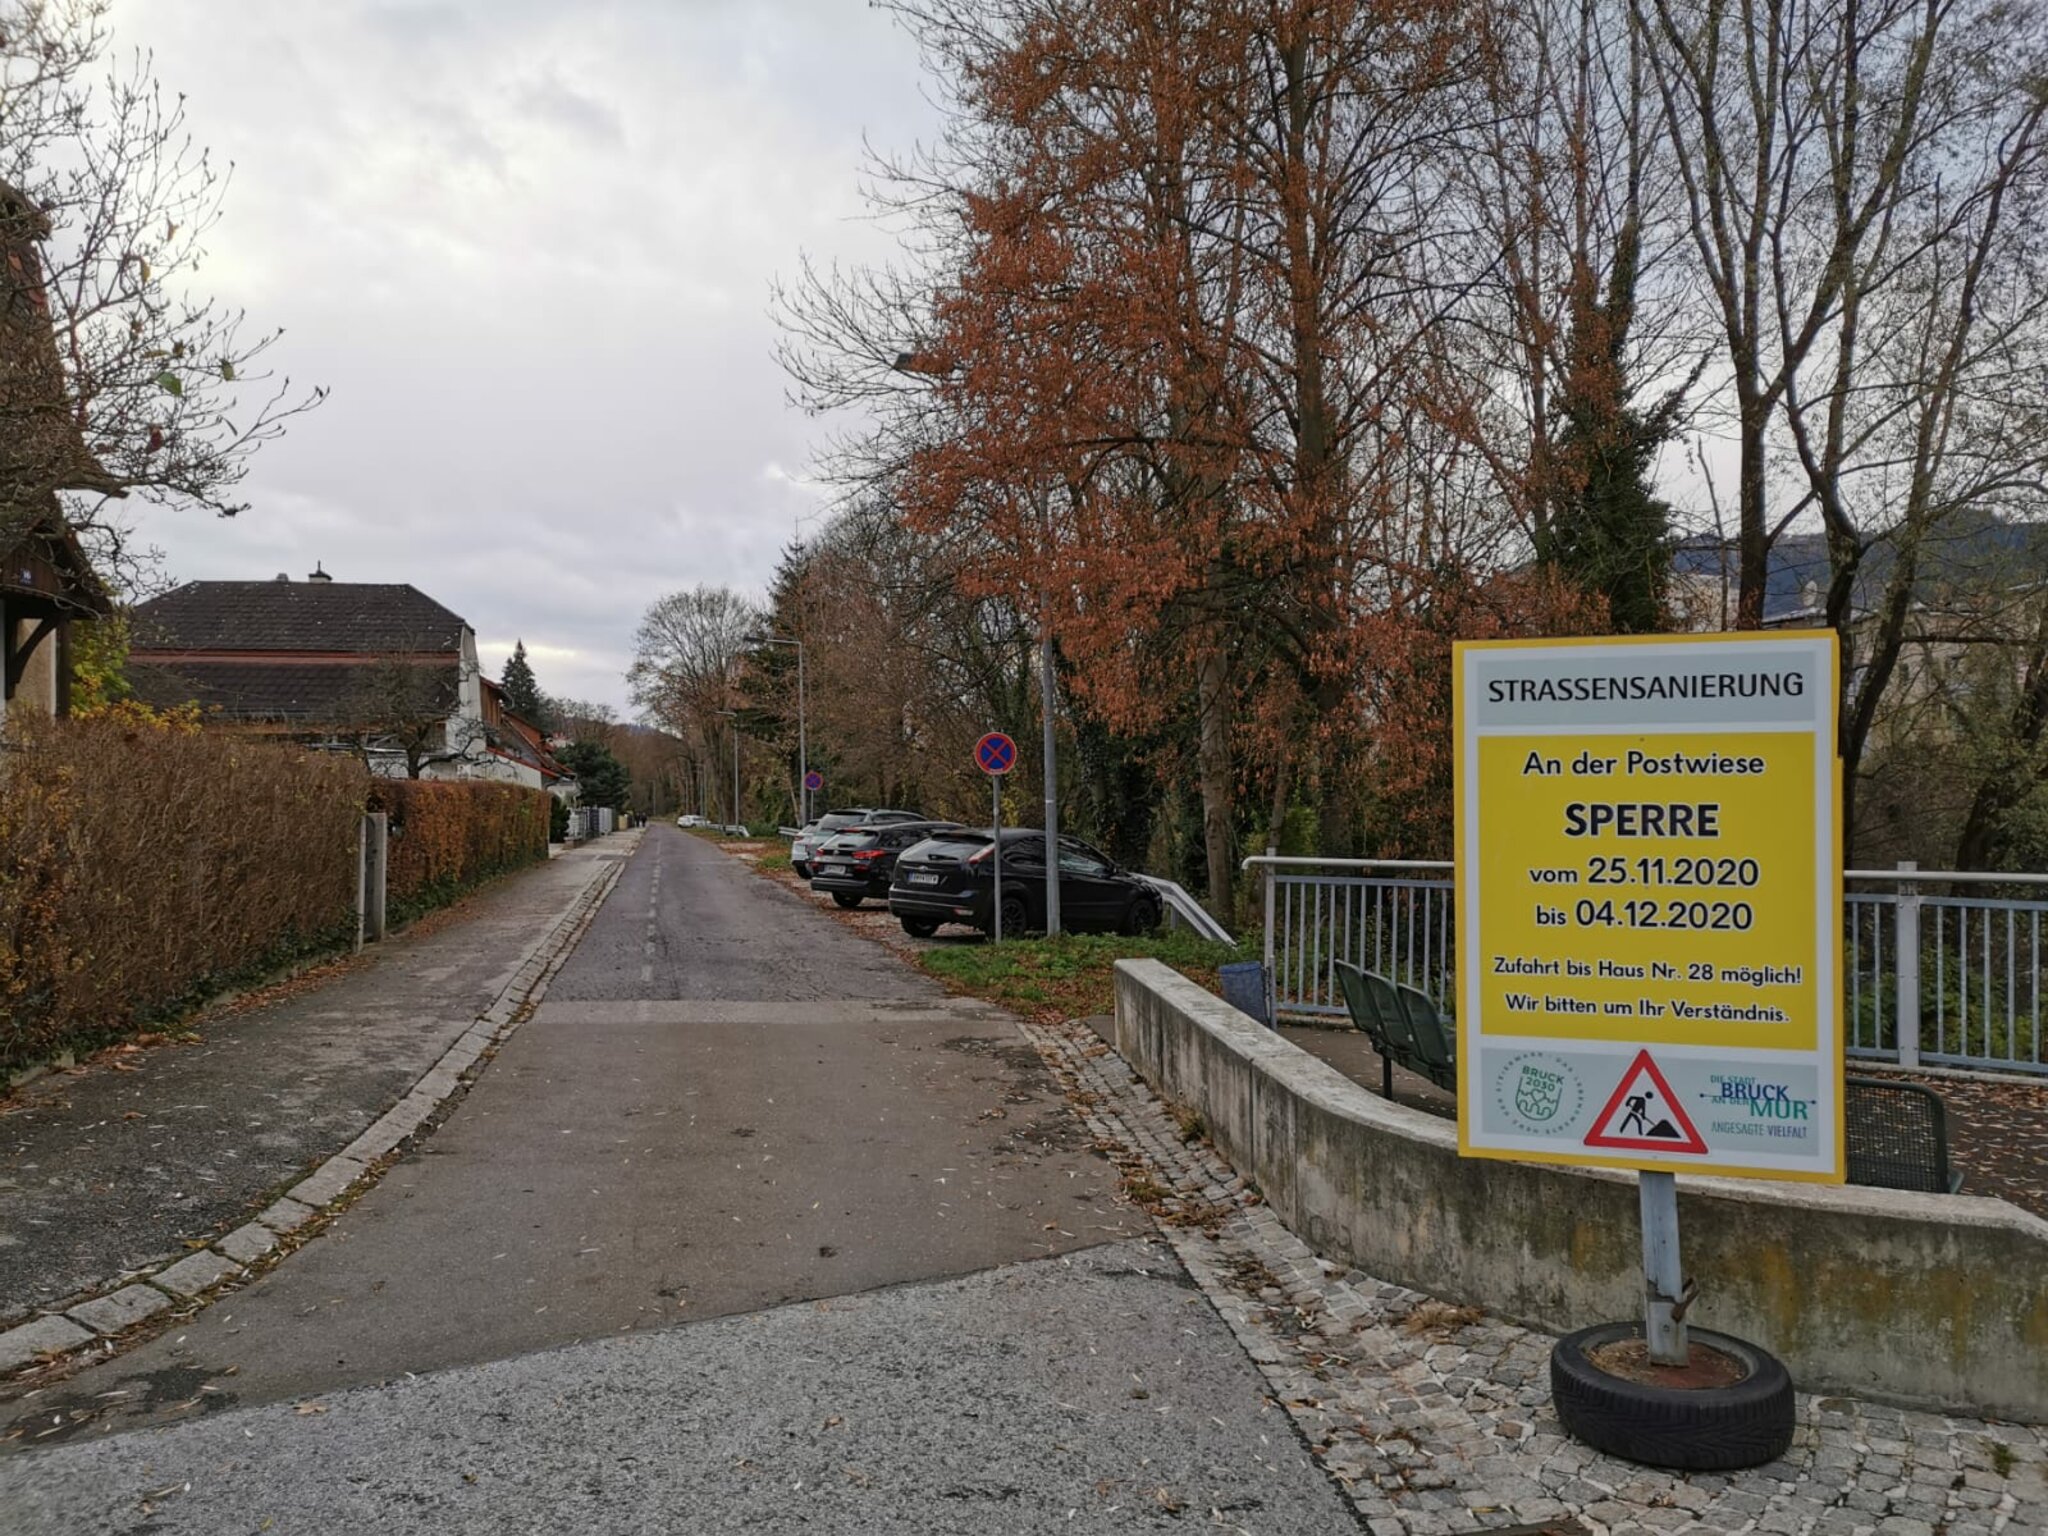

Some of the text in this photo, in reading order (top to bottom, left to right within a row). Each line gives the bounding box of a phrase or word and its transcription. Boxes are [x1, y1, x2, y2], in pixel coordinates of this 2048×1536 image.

[1488, 672, 1804, 703] STRASSENSANIERUNG
[1523, 751, 1765, 775] An der Postwiese
[1564, 803, 1720, 837] SPERRE
[1530, 857, 1760, 886] vom 25.11.2020
[1536, 900, 1753, 930] bis 04.12.2020
[1494, 957, 1802, 987] Zufahrt bis Haus Nr. 28 möglich!
[1505, 994, 1790, 1022] Wir bitten um Ihr Verständnis.
[1522, 1065, 1565, 1085] BRUCK
[1526, 1077, 1556, 1092] 2030
[1722, 1082, 1789, 1102] BRUCK
[1750, 1100, 1808, 1120] MUR
[1711, 1121, 1808, 1139] ANGESAGTE VIELFALT
